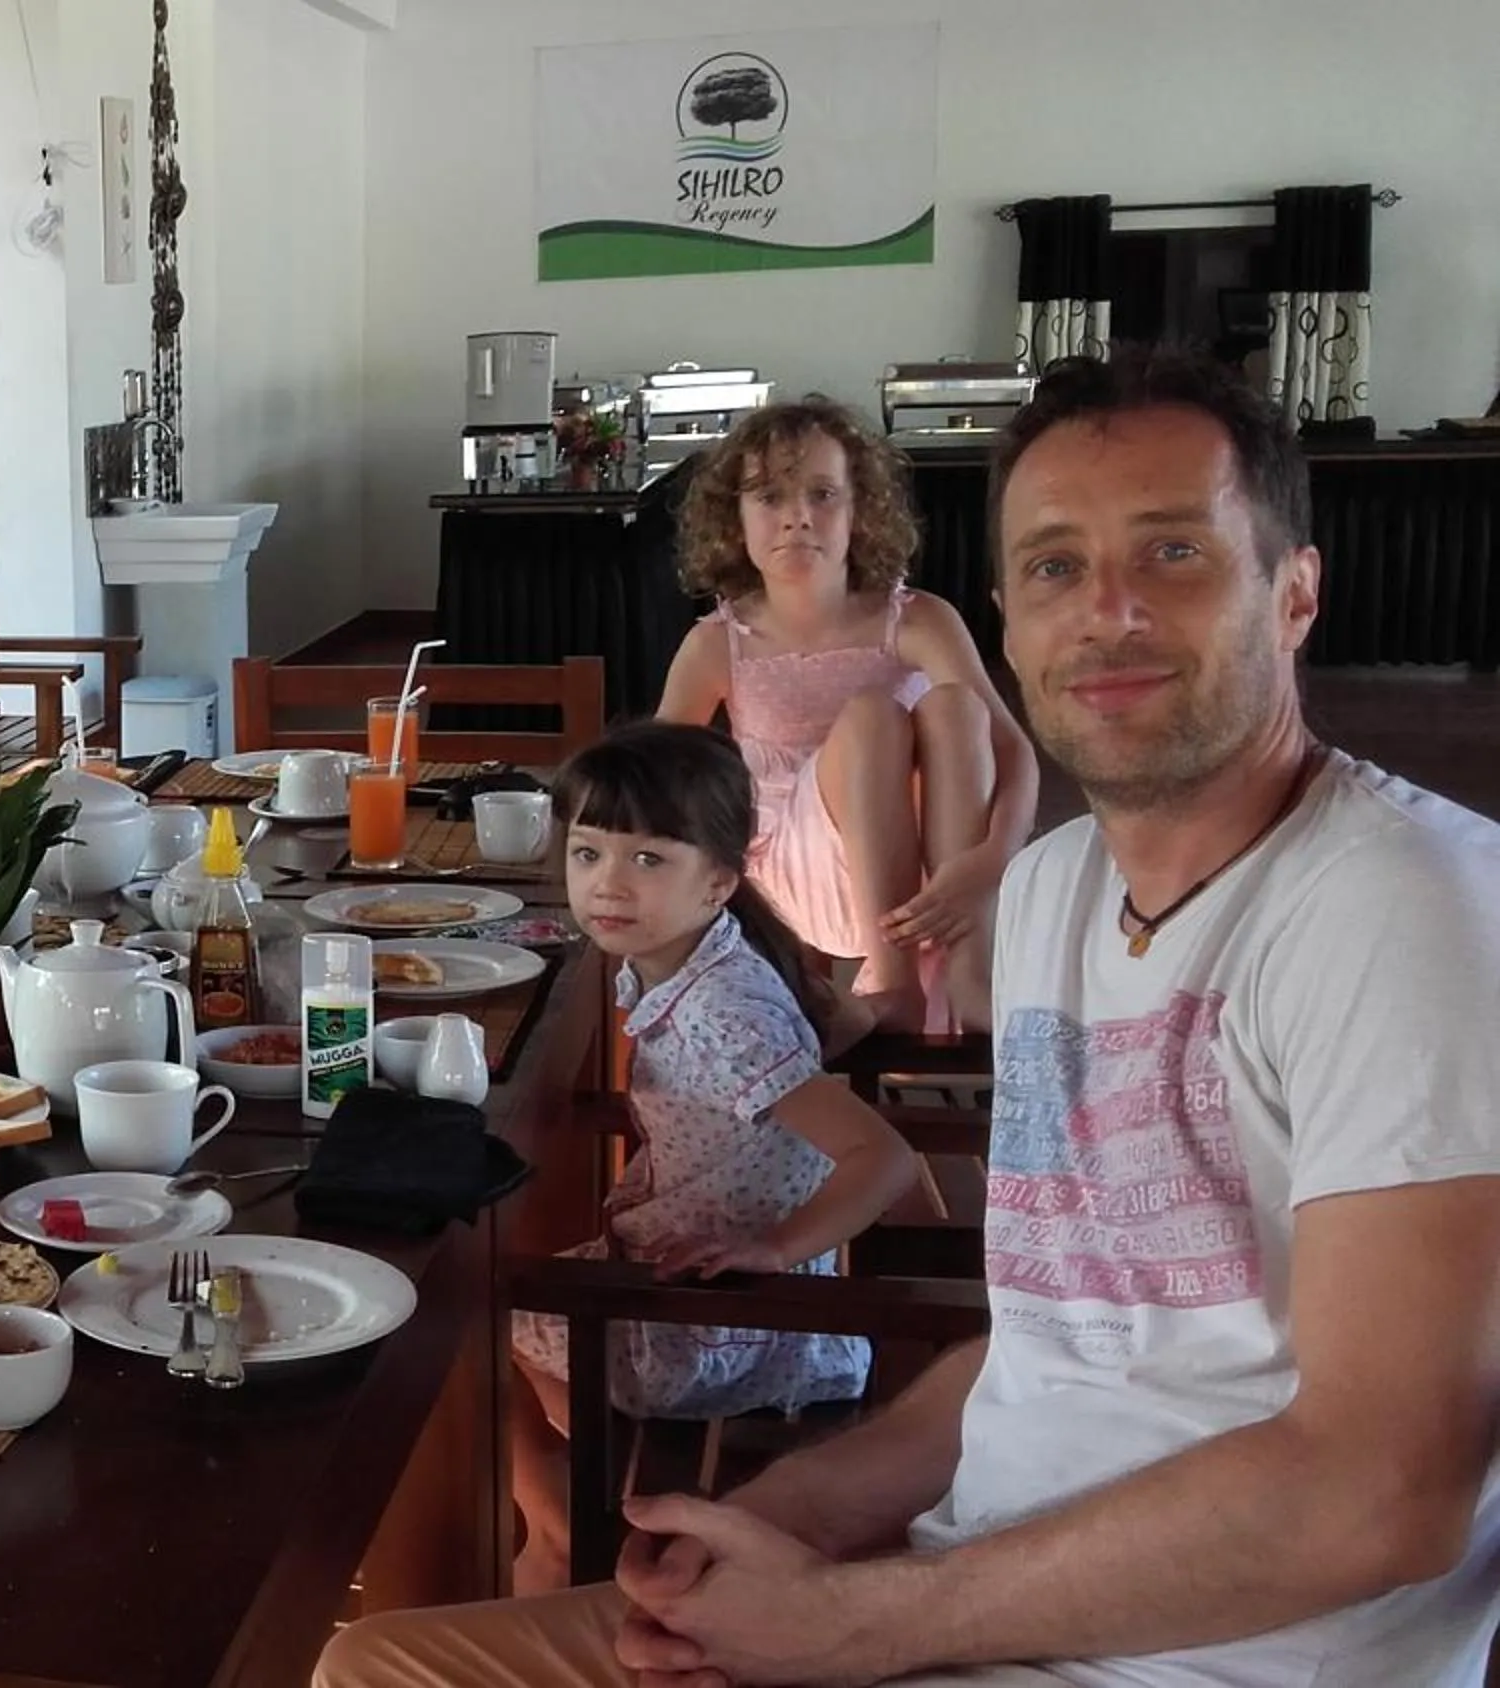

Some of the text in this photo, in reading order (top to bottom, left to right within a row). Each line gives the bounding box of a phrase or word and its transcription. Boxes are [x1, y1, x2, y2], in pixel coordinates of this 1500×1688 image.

[677, 167, 783, 202] SIHILRO
[678, 200, 777, 231] Regency
[310, 1044, 366, 1065] MUGGA
